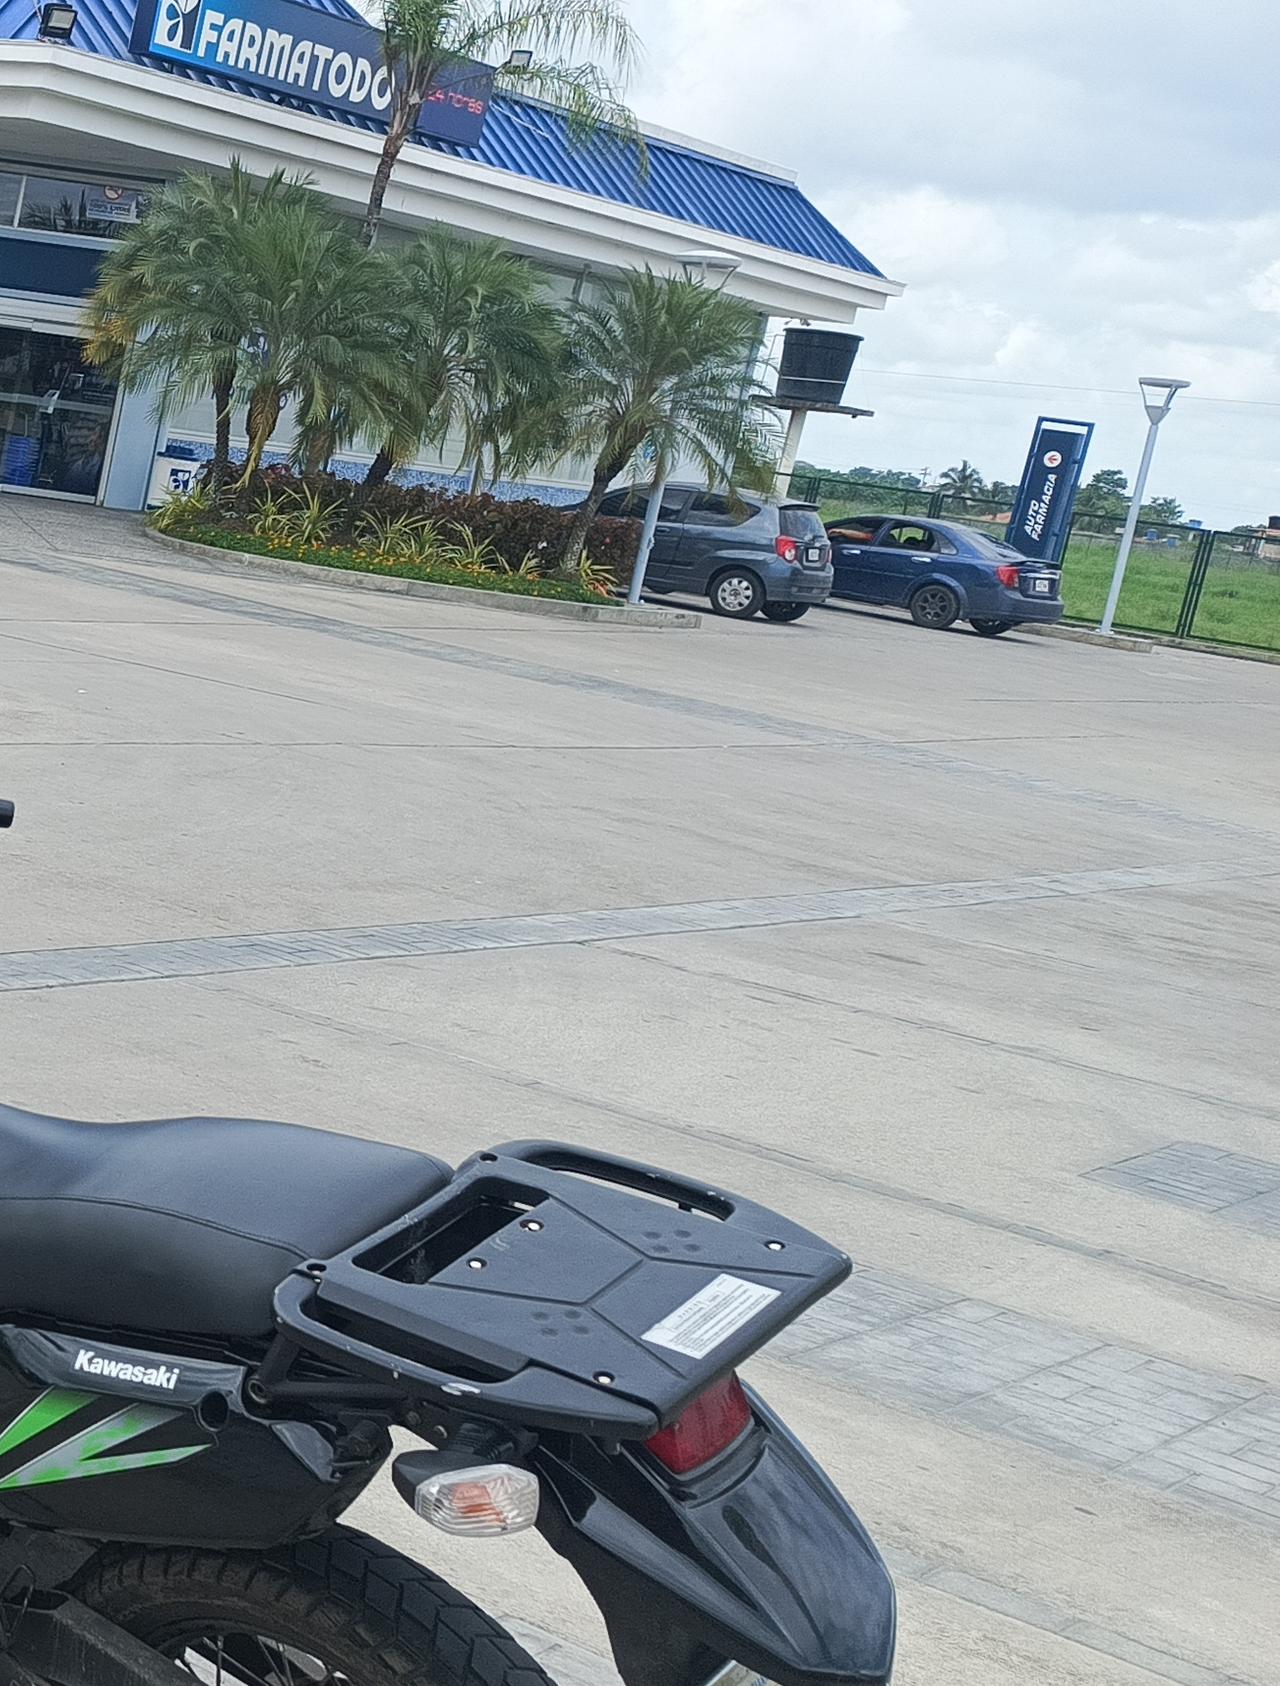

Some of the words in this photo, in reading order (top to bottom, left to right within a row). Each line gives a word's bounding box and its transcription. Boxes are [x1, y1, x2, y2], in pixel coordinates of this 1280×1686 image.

[196, 9, 393, 111] FARMATODO
[1024, 499, 1040, 536] AUTO
[1031, 473, 1058, 542] FARMACIA
[73, 1348, 180, 1390] Kawasaki
